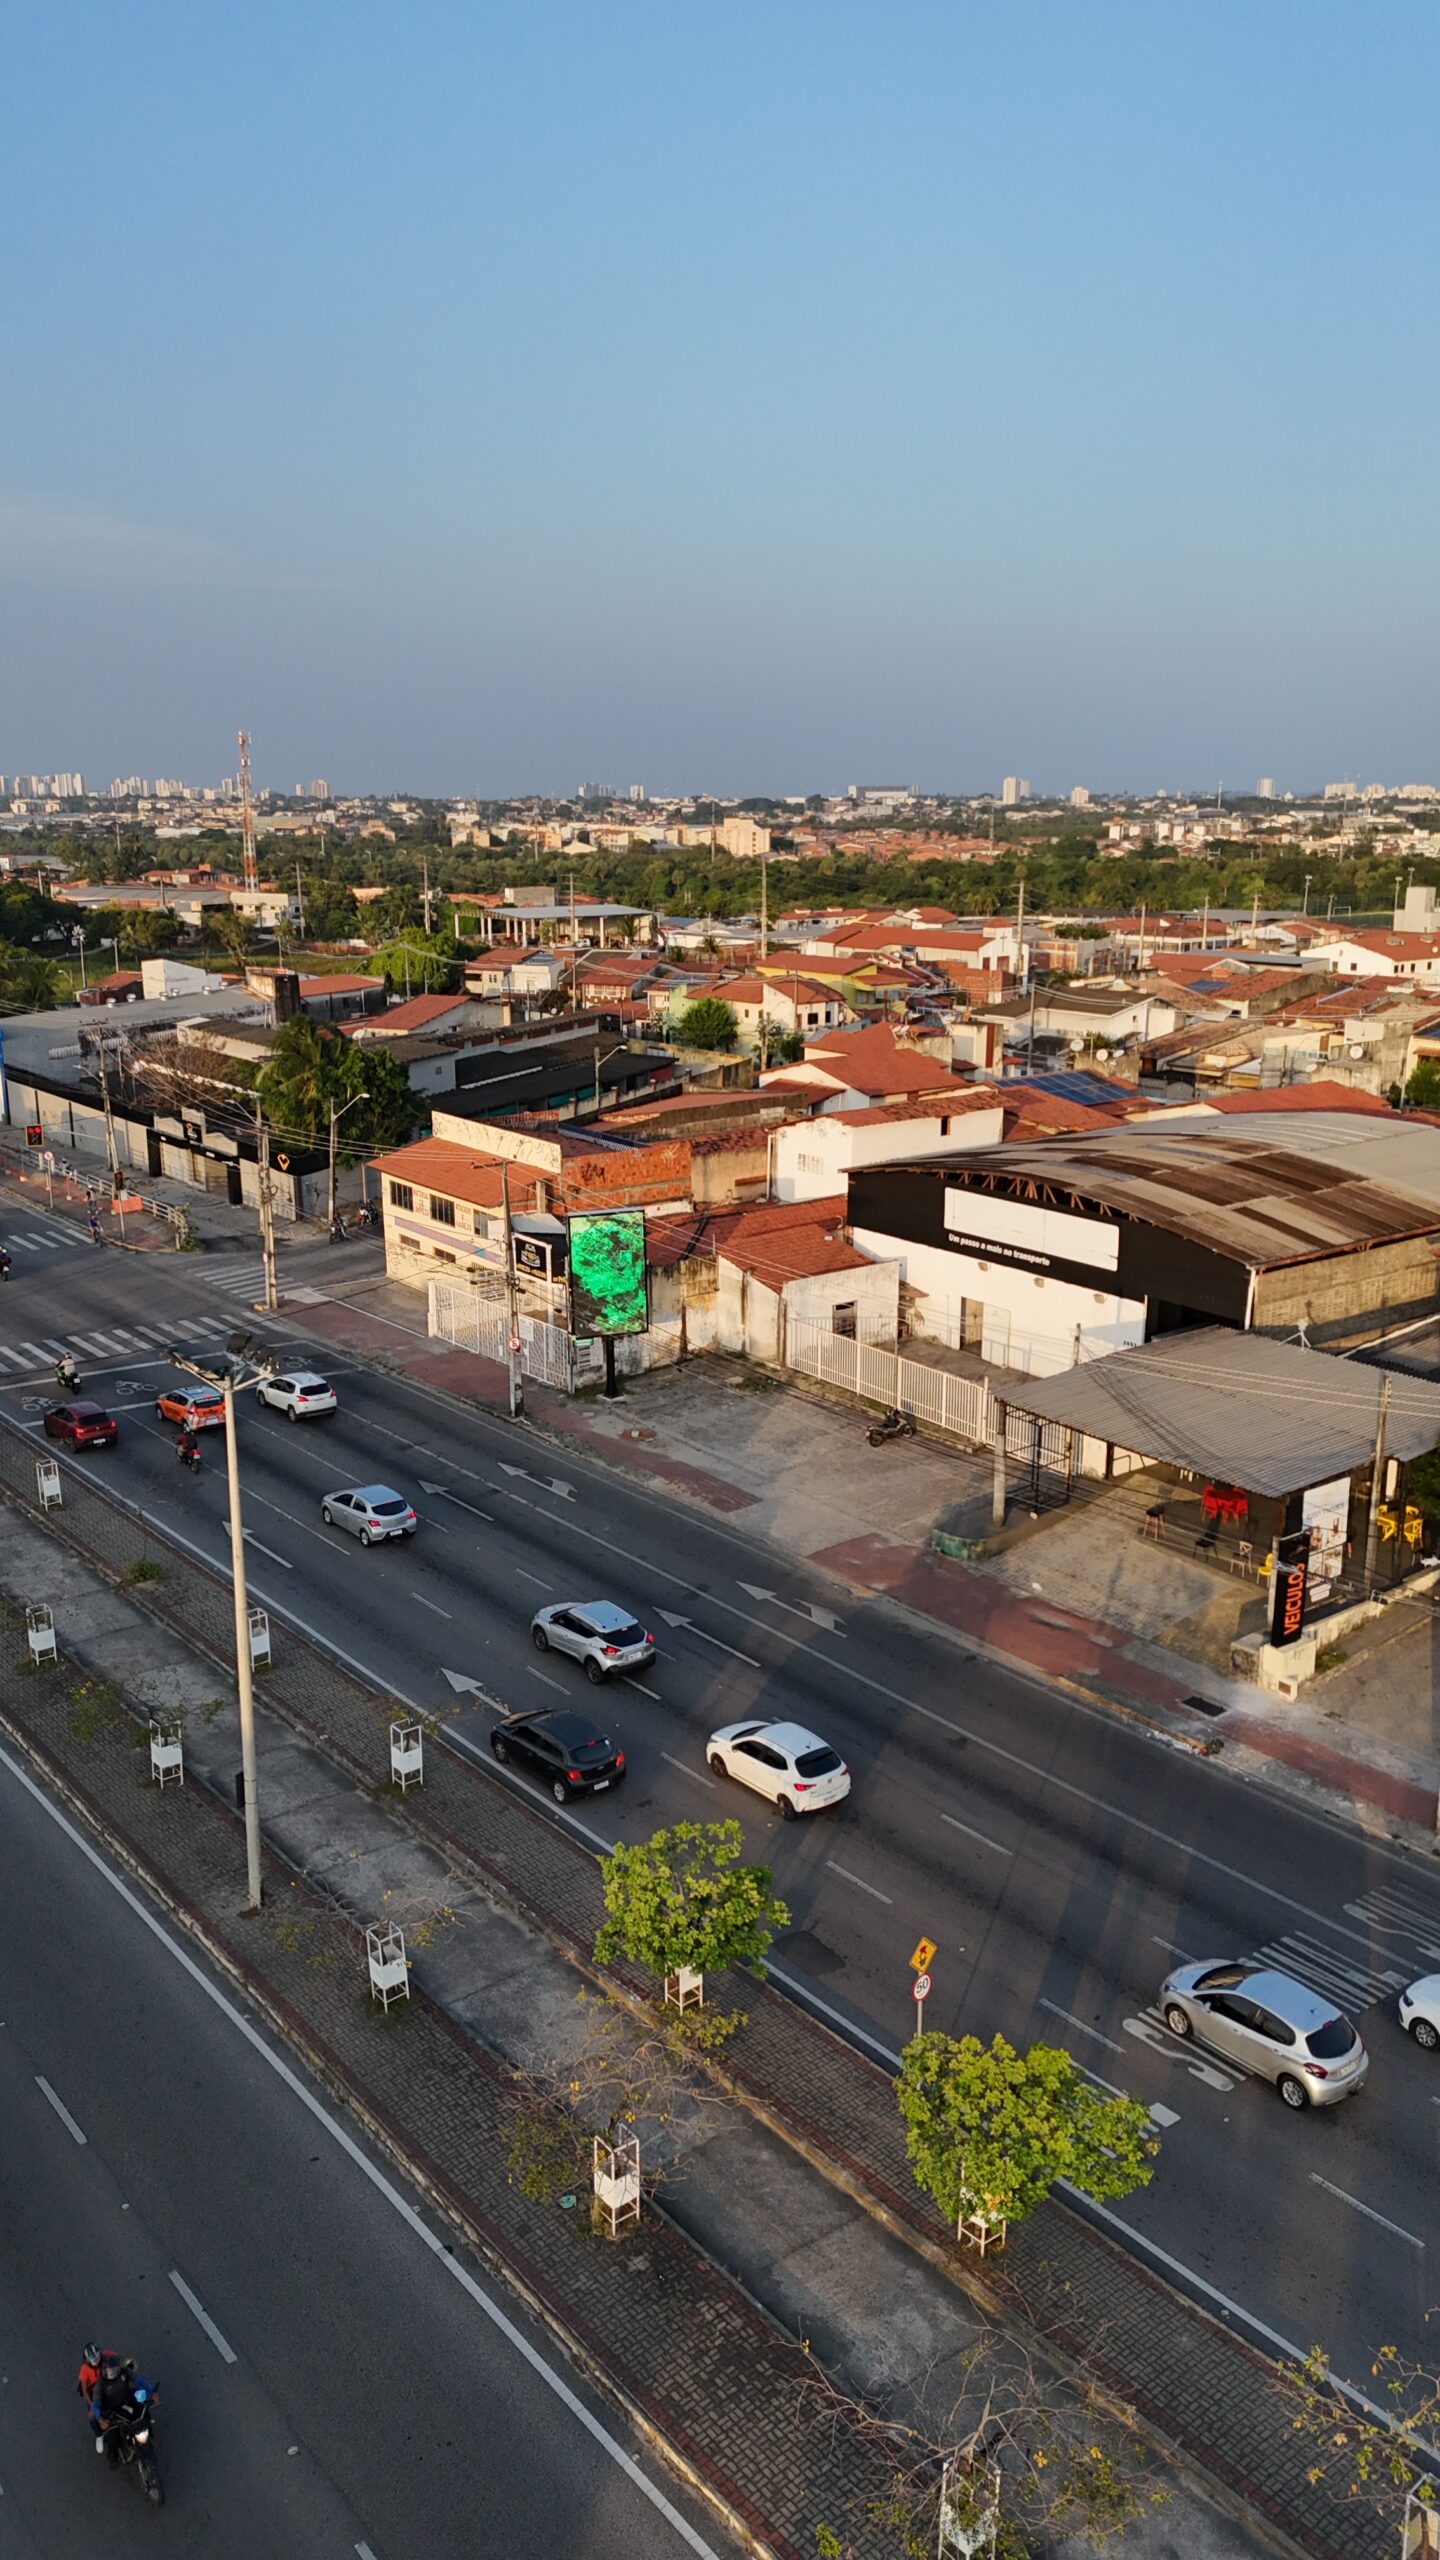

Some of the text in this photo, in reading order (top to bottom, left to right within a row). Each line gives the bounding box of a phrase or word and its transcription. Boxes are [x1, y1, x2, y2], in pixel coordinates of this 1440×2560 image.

[948, 1233, 1051, 1266] Um passo a mais no transporte
[1284, 1563, 1305, 1635] VEICULOS
[916, 1978, 928, 1993] 50
